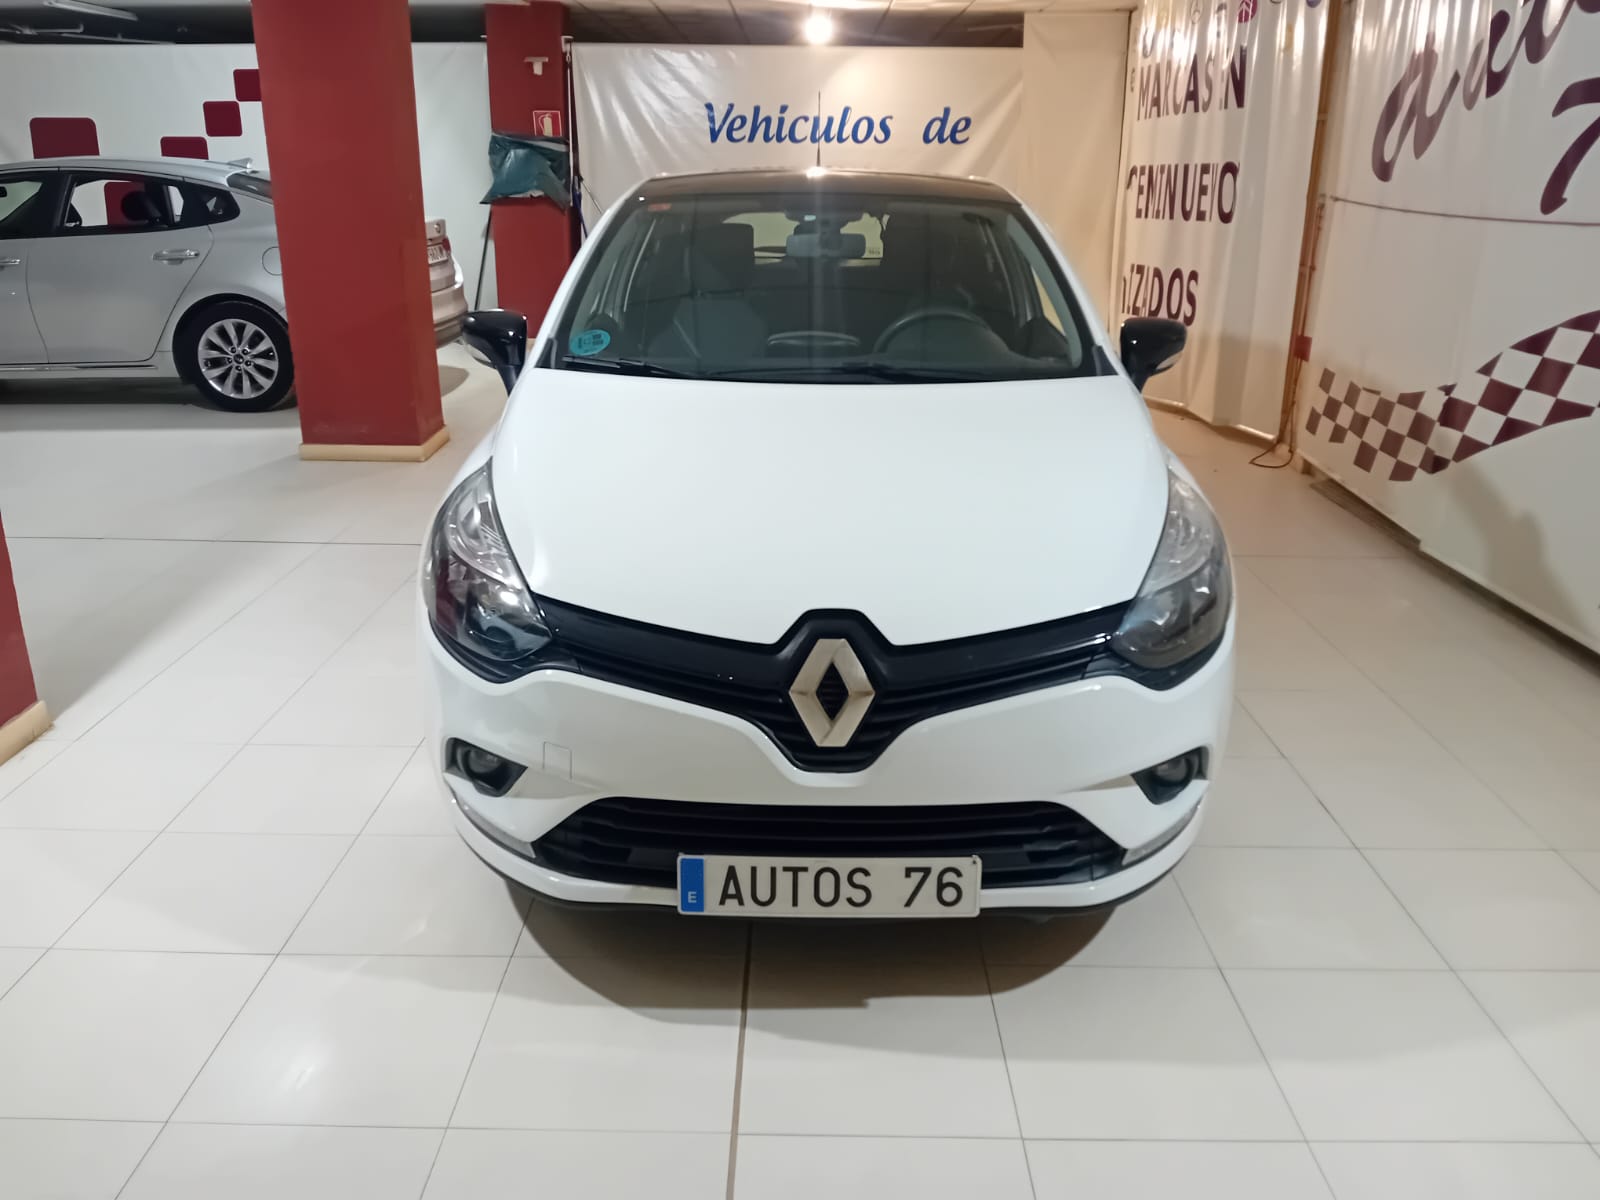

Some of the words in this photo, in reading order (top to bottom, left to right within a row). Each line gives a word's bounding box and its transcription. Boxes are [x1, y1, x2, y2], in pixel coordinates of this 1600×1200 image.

[922, 106, 972, 145] de
[1121, 264, 1199, 327] IZADOS
[687, 891, 697, 903] E
[718, 865, 872, 907] AUTOS
[903, 866, 964, 907] 76
